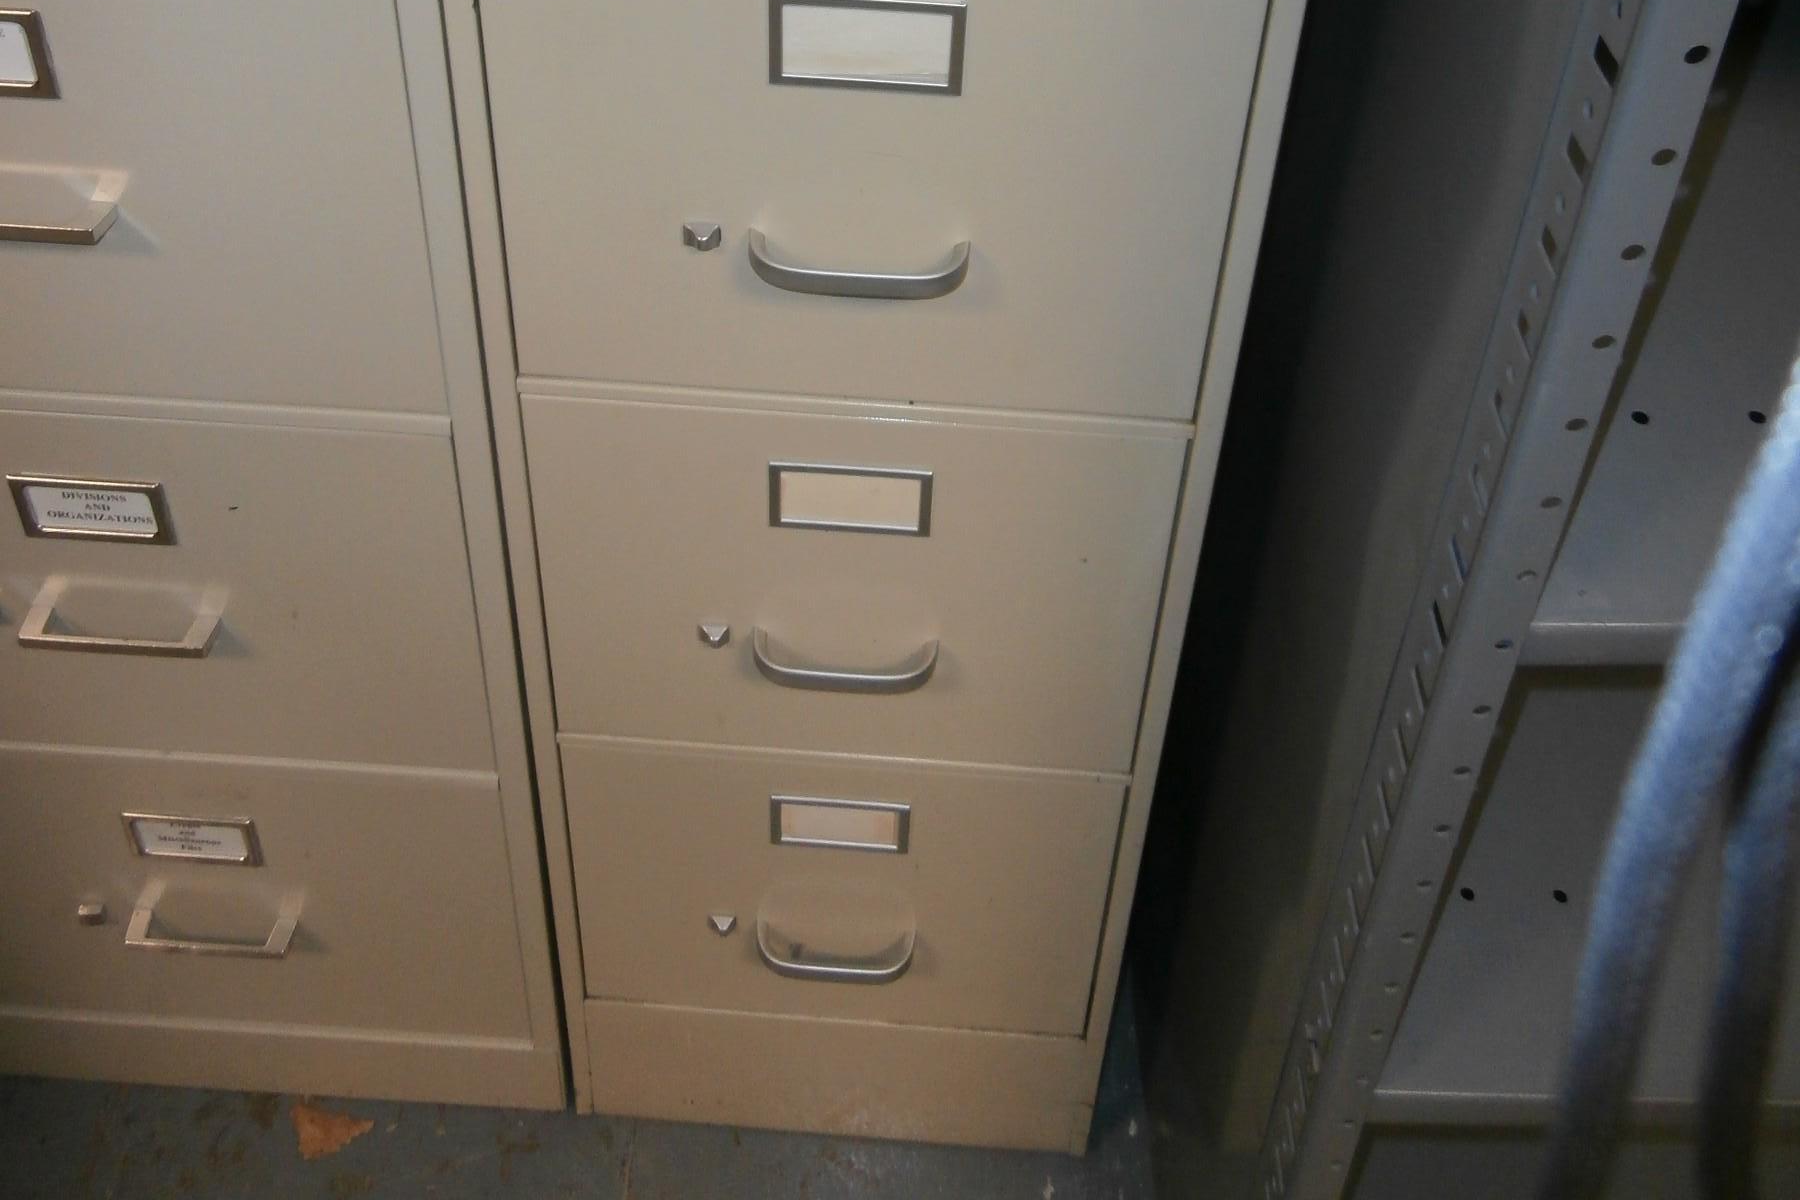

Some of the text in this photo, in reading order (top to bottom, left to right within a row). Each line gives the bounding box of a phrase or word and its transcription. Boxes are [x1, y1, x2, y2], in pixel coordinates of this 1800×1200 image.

[61, 490, 128, 503] DIVISIONS
[85, 502, 111, 512] AND
[47, 509, 154, 525] ORGANIZATIONS
